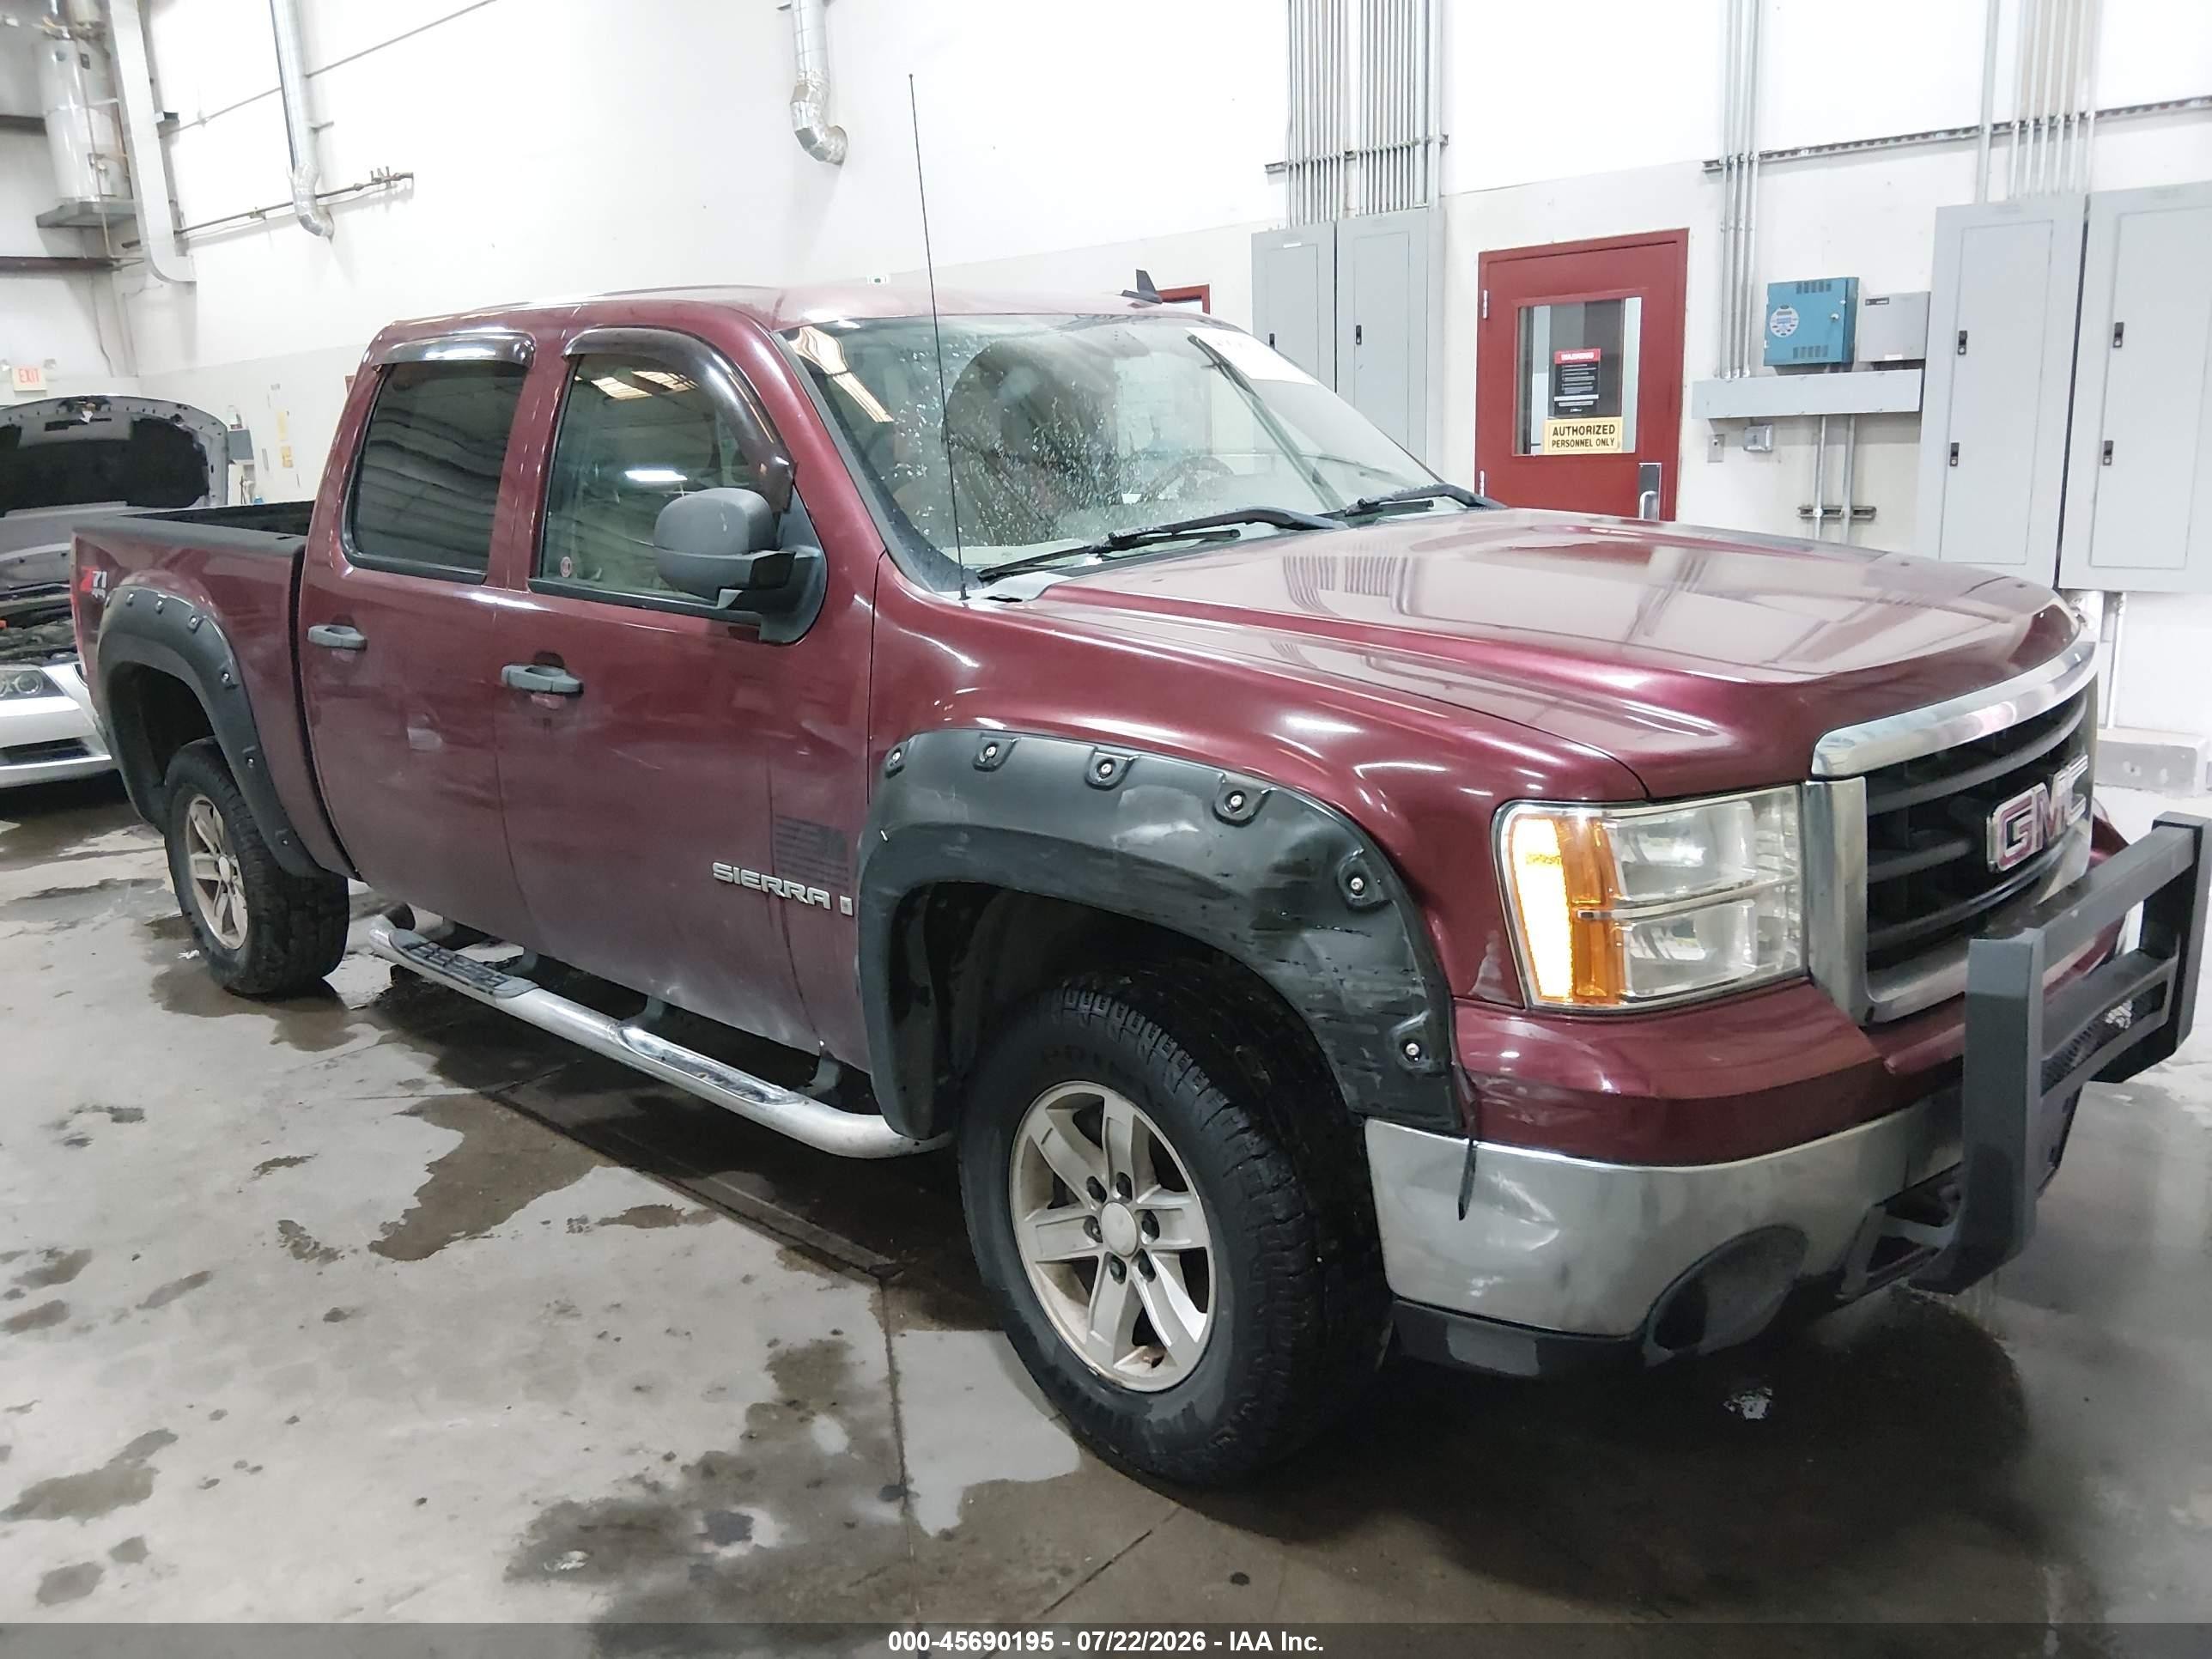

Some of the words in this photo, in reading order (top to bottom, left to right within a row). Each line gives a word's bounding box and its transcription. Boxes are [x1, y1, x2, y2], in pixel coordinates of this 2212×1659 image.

[19, 368, 40, 383] EXIT
[1553, 424, 1615, 436] AUTHORIZED
[1552, 439, 1593, 448] PERSONNEL
[1595, 438, 1614, 447] ONLY
[79, 565, 107, 592] Z71
[1987, 755, 2088, 872] GMC
[713, 862, 831, 910] SIERRA
